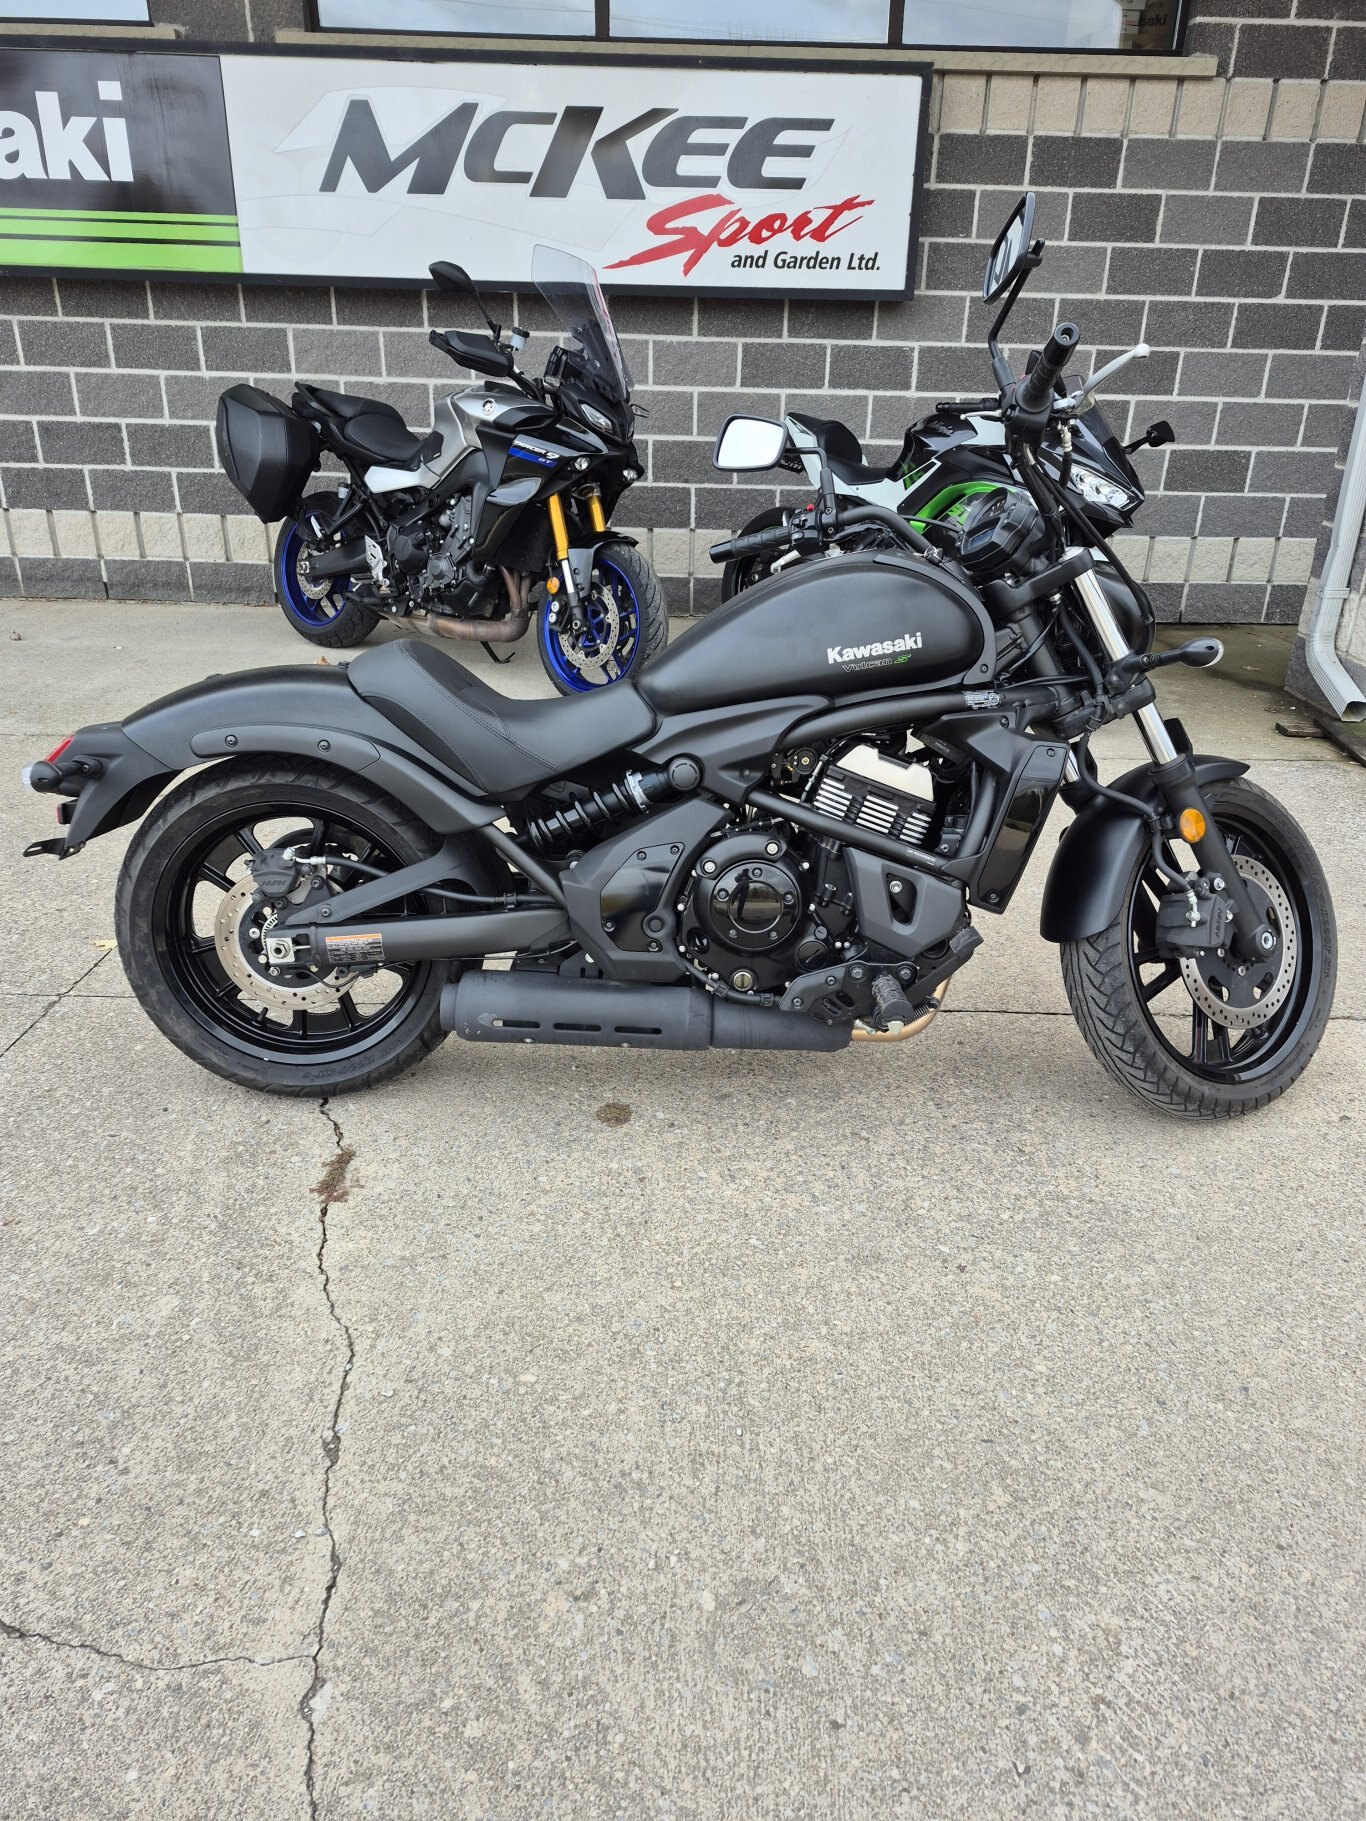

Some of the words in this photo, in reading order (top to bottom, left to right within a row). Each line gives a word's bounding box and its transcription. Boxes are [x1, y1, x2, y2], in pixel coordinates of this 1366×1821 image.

[0, 80, 134, 182] aki
[602, 193, 875, 278] Sport
[730, 249, 769, 269] and
[773, 250, 842, 270] Garden
[846, 251, 881, 271] Ltd.
[513, 440, 547, 455] TRACER
[545, 451, 560, 460] 9
[826, 631, 923, 664] Kawasaki
[842, 658, 893, 672] Vulcan
